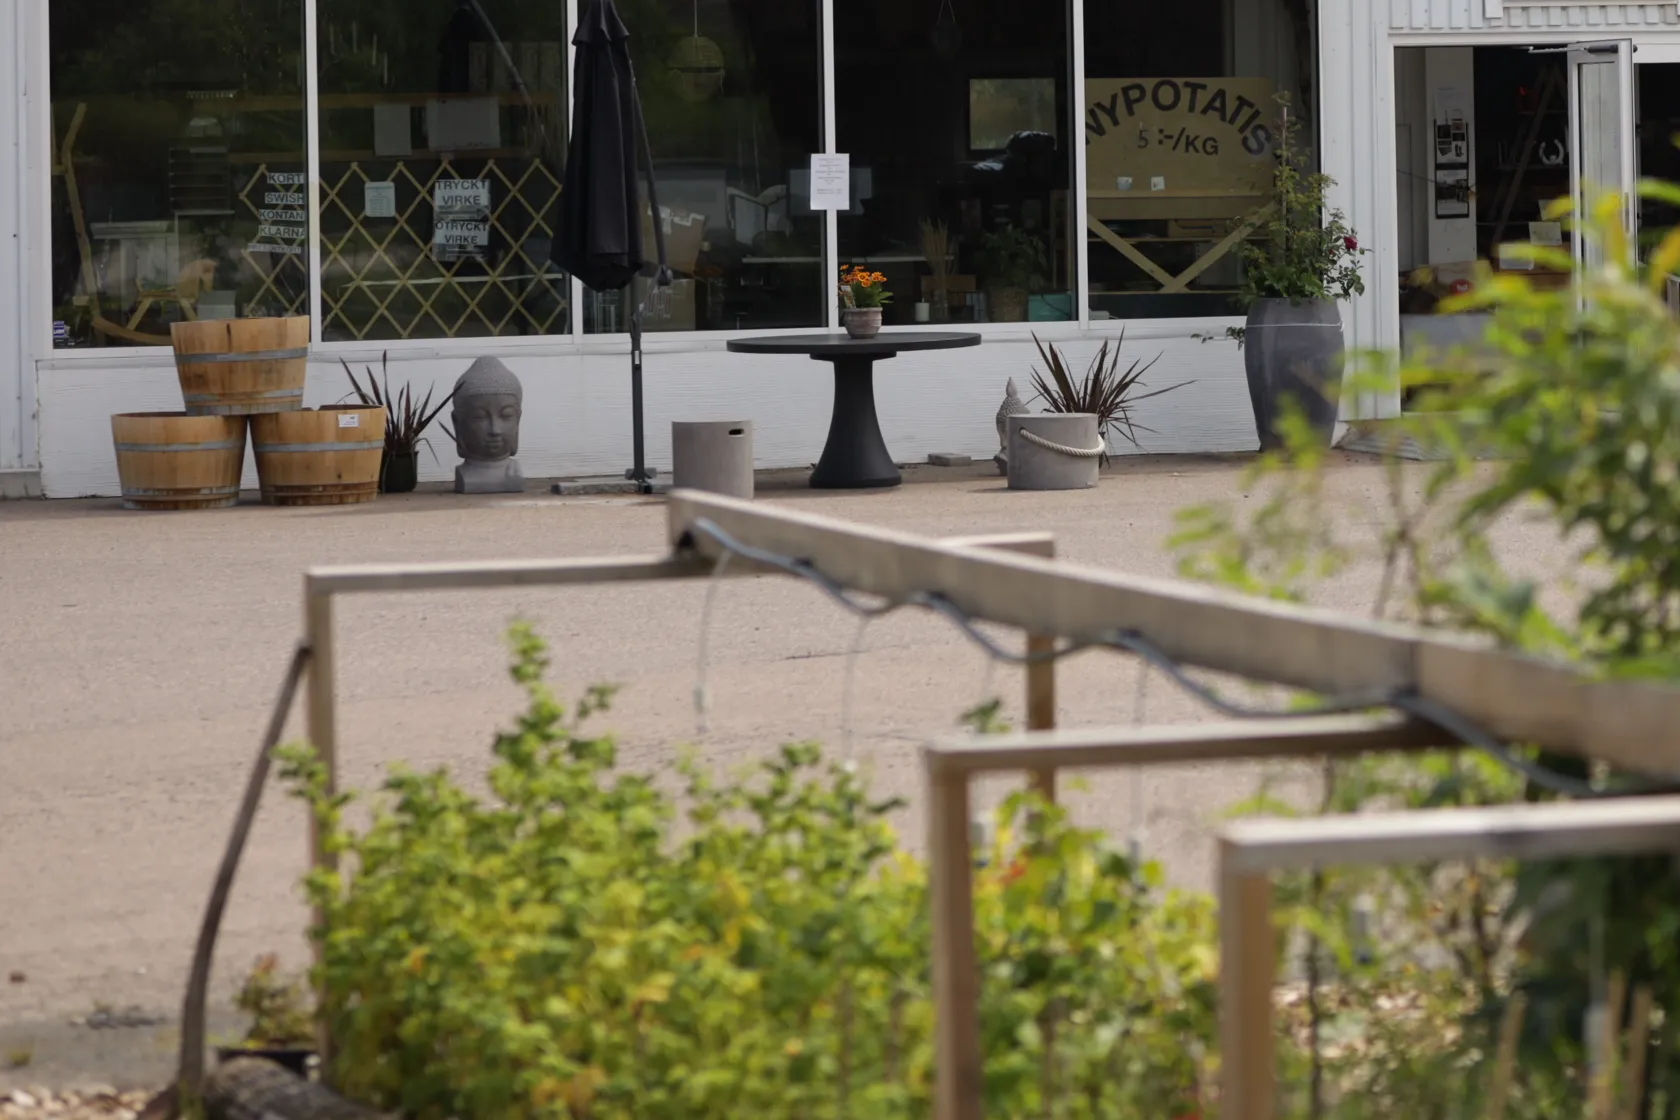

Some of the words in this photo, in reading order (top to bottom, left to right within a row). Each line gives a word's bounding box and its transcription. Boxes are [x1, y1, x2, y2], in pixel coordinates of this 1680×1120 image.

[1085, 79, 1272, 156] NYPOTATIS
[268, 173, 302, 184] KORT
[435, 180, 487, 191] TRYCKT
[265, 193, 305, 204] SWISH
[442, 194, 481, 206] VIRKE
[259, 210, 303, 220] KONTAN
[434, 220, 488, 232] OTRYCKT
[444, 235, 478, 245] VIRKE
